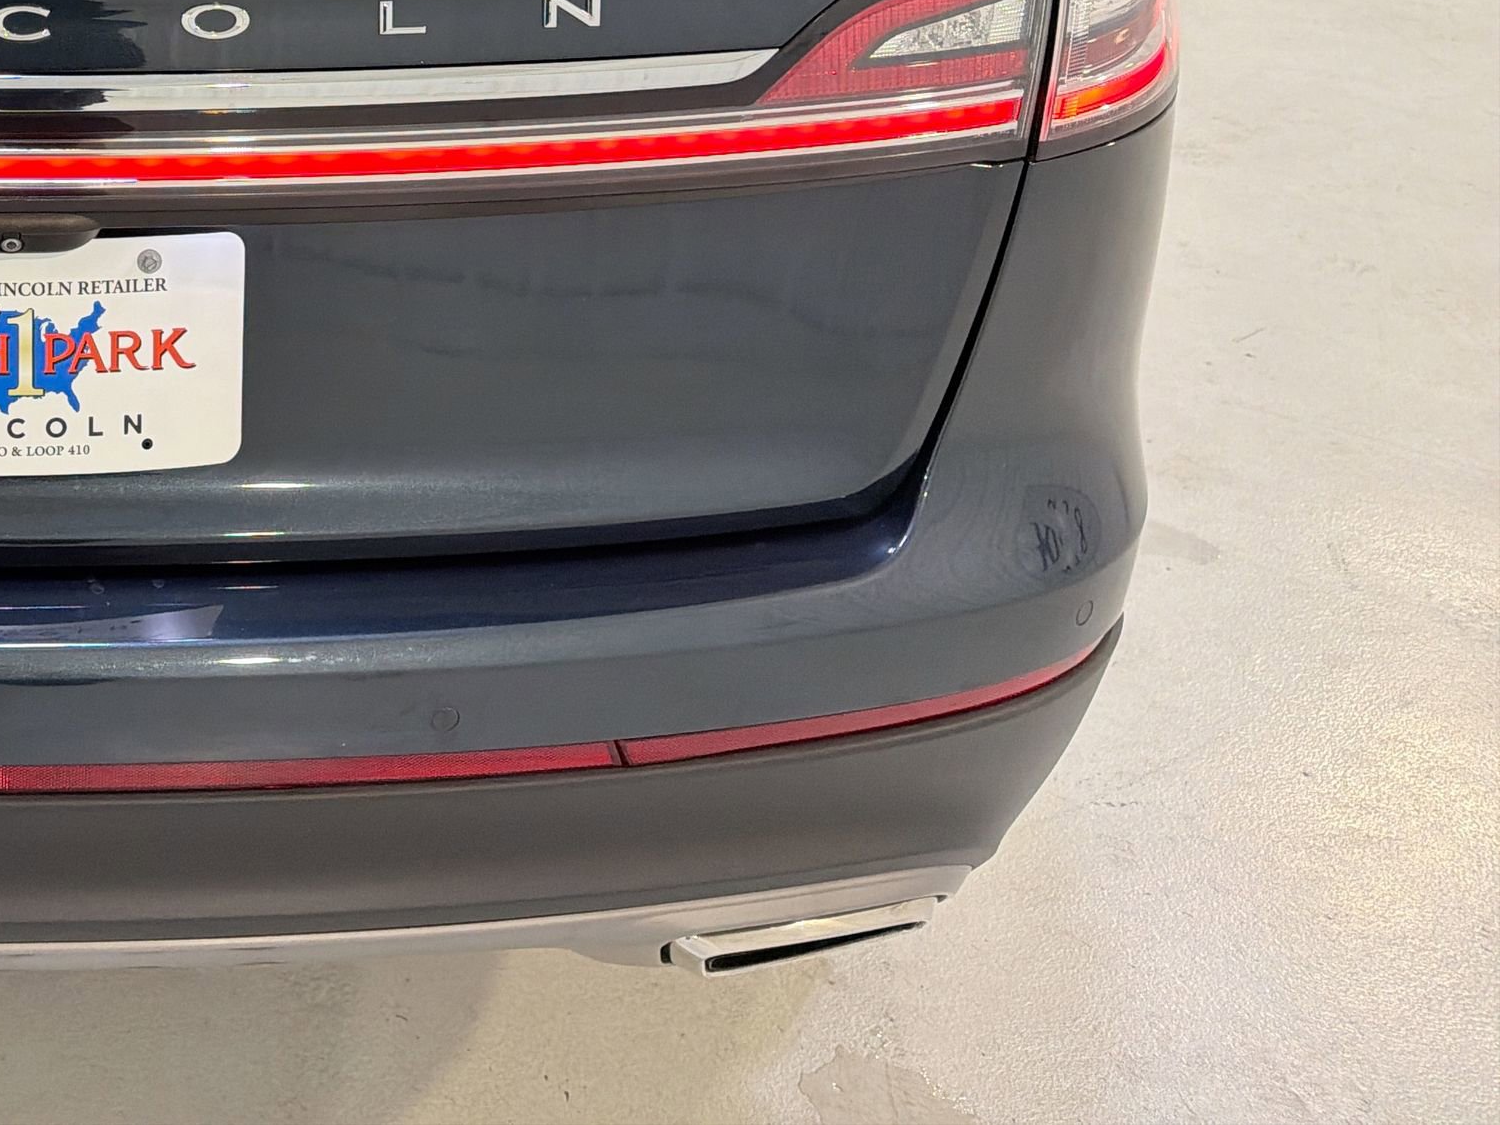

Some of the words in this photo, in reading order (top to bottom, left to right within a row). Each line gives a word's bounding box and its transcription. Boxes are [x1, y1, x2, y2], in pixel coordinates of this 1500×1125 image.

[77, 277, 168, 296] RETAILER
[43, 327, 197, 375] PARK
[11, 446, 23, 458] &
[26, 445, 65, 457] LOOP
[67, 444, 91, 456] 410
